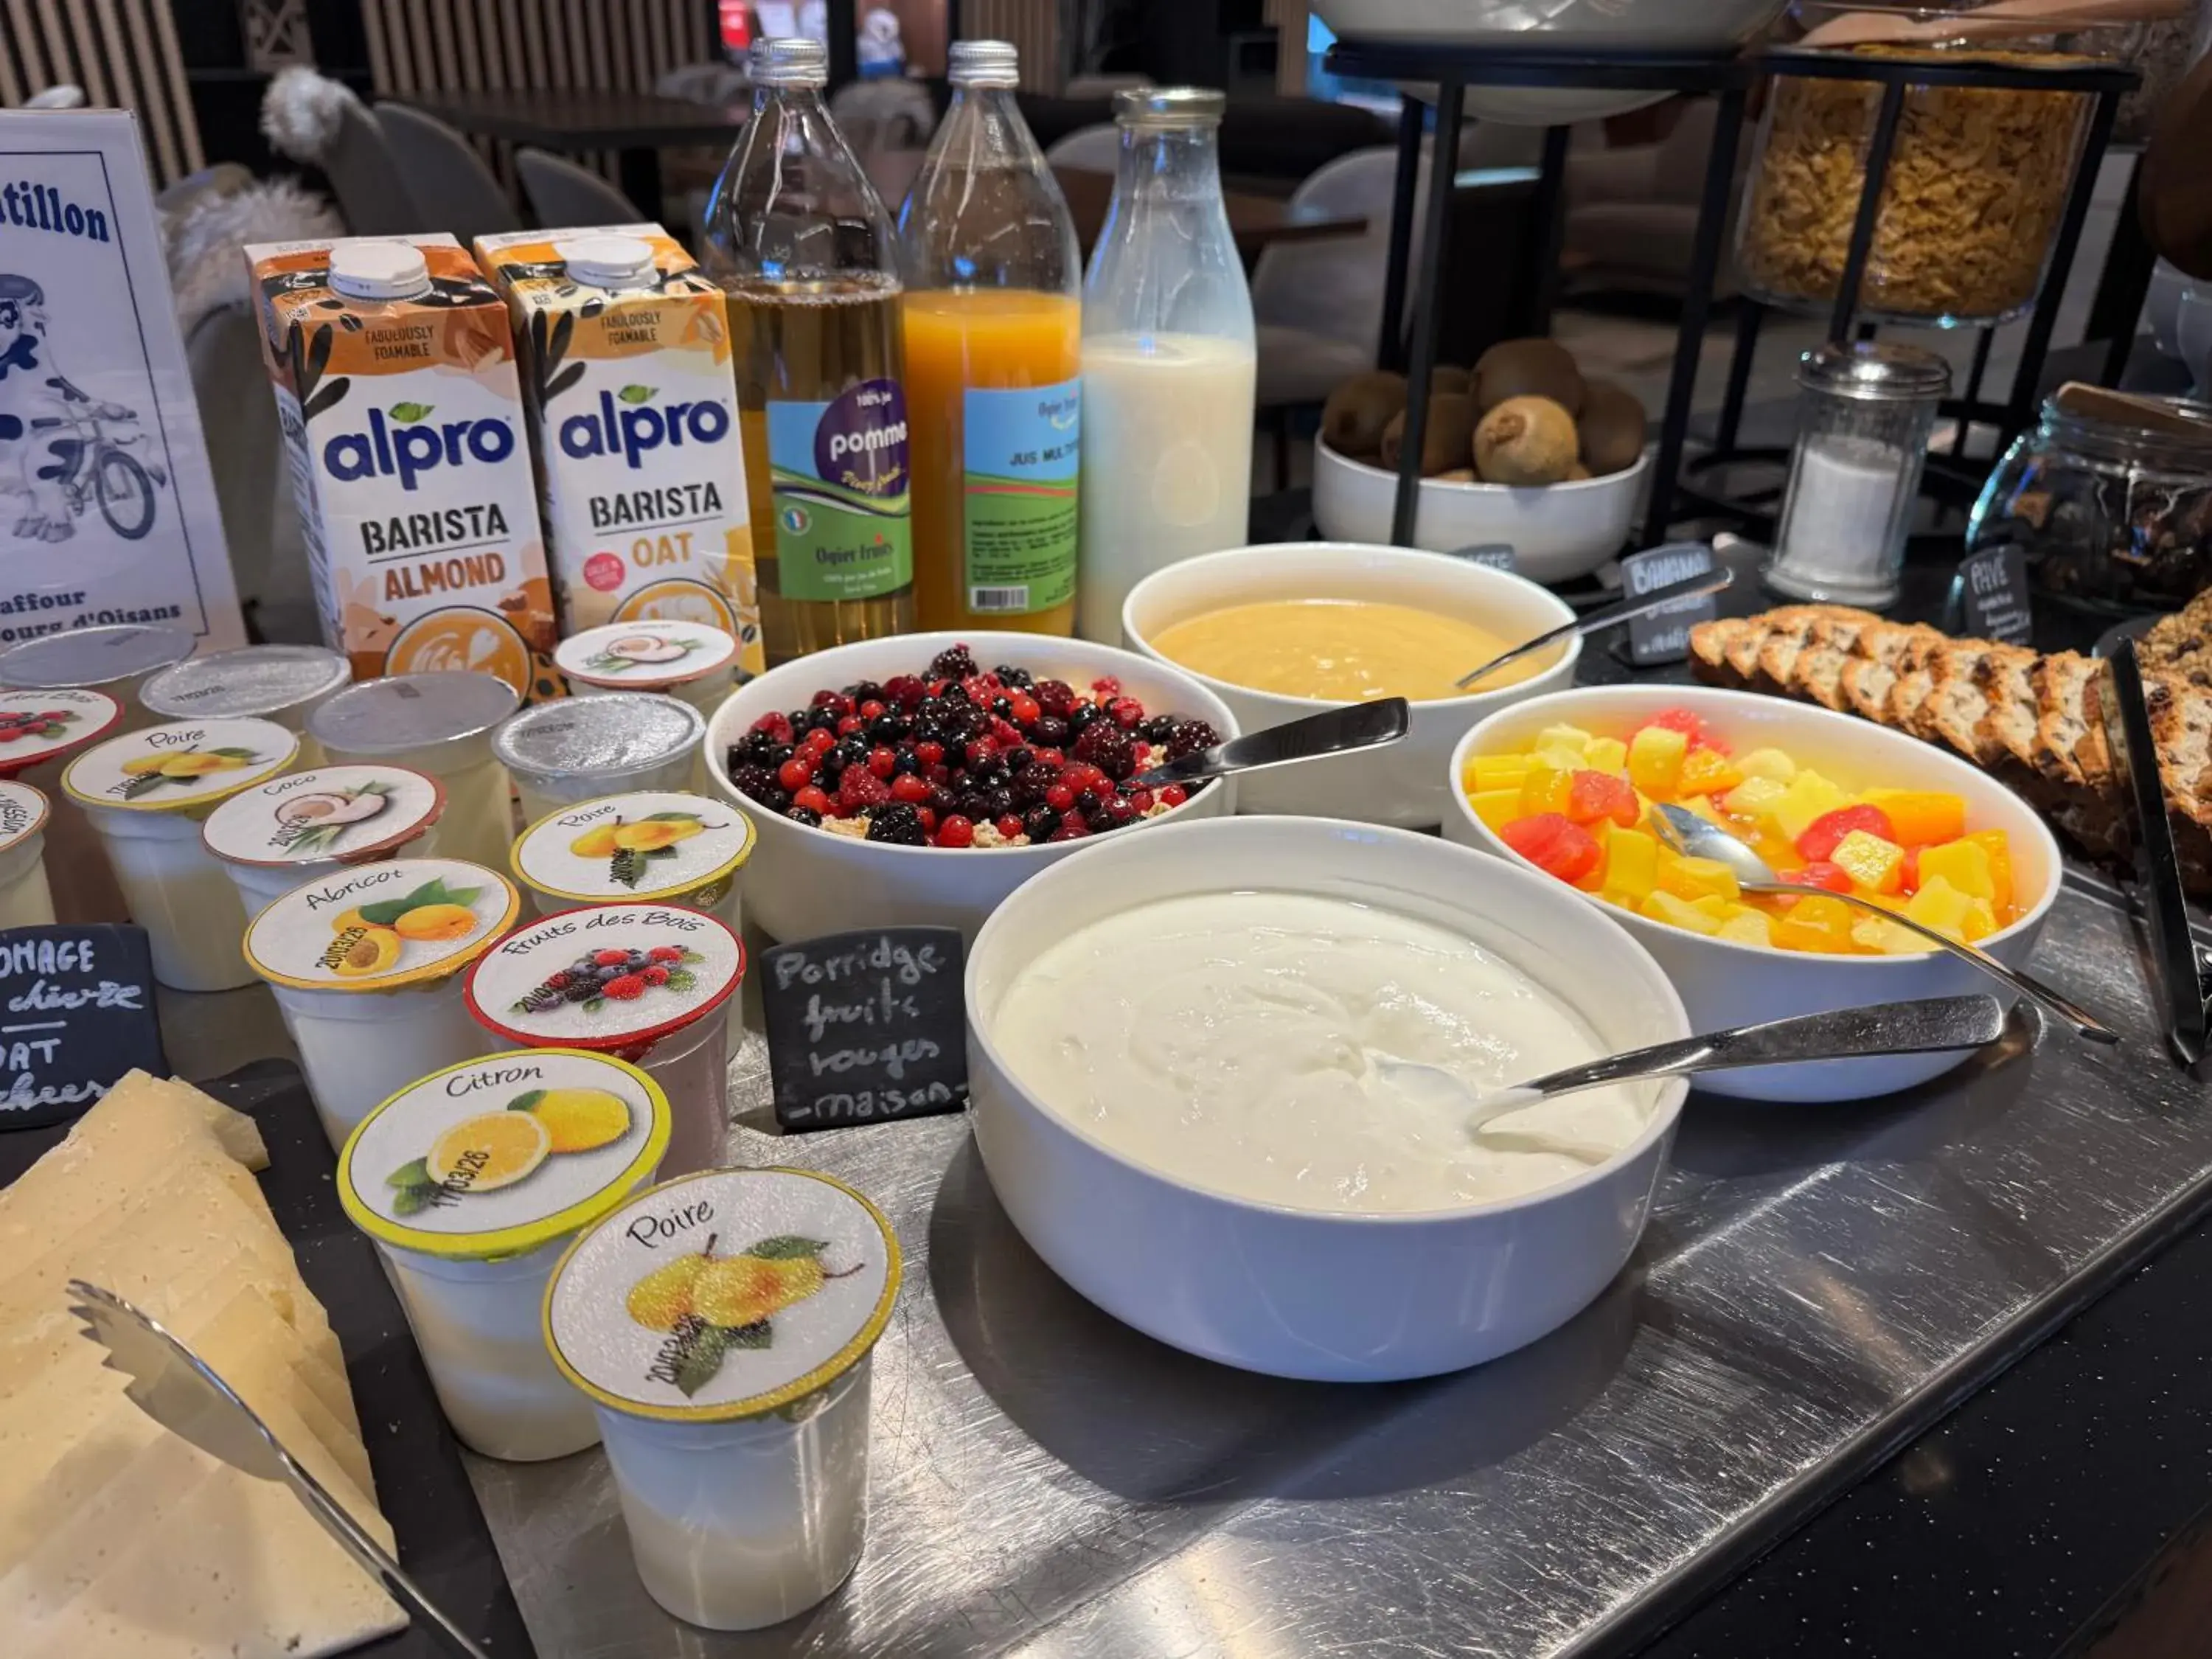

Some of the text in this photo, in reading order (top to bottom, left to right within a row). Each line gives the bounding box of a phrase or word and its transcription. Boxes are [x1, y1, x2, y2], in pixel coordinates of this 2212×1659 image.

[365, 325, 434, 343] FABULOUSLY
[600, 310, 661, 329] FABULOUSLY
[608, 329, 657, 346] FOAMABLE
[374, 342, 431, 361] FOAMABLE
[324, 408, 515, 491] alpro
[559, 389, 730, 469] alpro
[830, 420, 908, 462] pomme
[1009, 451, 1037, 466] JUS
[589, 481, 723, 528] BARISTA
[360, 502, 509, 555] BARISTA
[632, 531, 694, 568] OAT
[385, 552, 507, 602] ALMOND
[71, 604, 181, 627] d'Oisans
[145, 728, 206, 748] Poire
[263, 775, 317, 796] Coco
[557, 804, 616, 827] Poire
[306, 869, 403, 911] Abricot
[501, 910, 706, 956] Fruits des Bois
[775, 934, 947, 990] Porridge
[801, 975, 921, 1044] fruits
[808, 1037, 941, 1081] rouges
[446, 1066, 543, 1098] Citron
[626, 1200, 714, 1249] Poire
